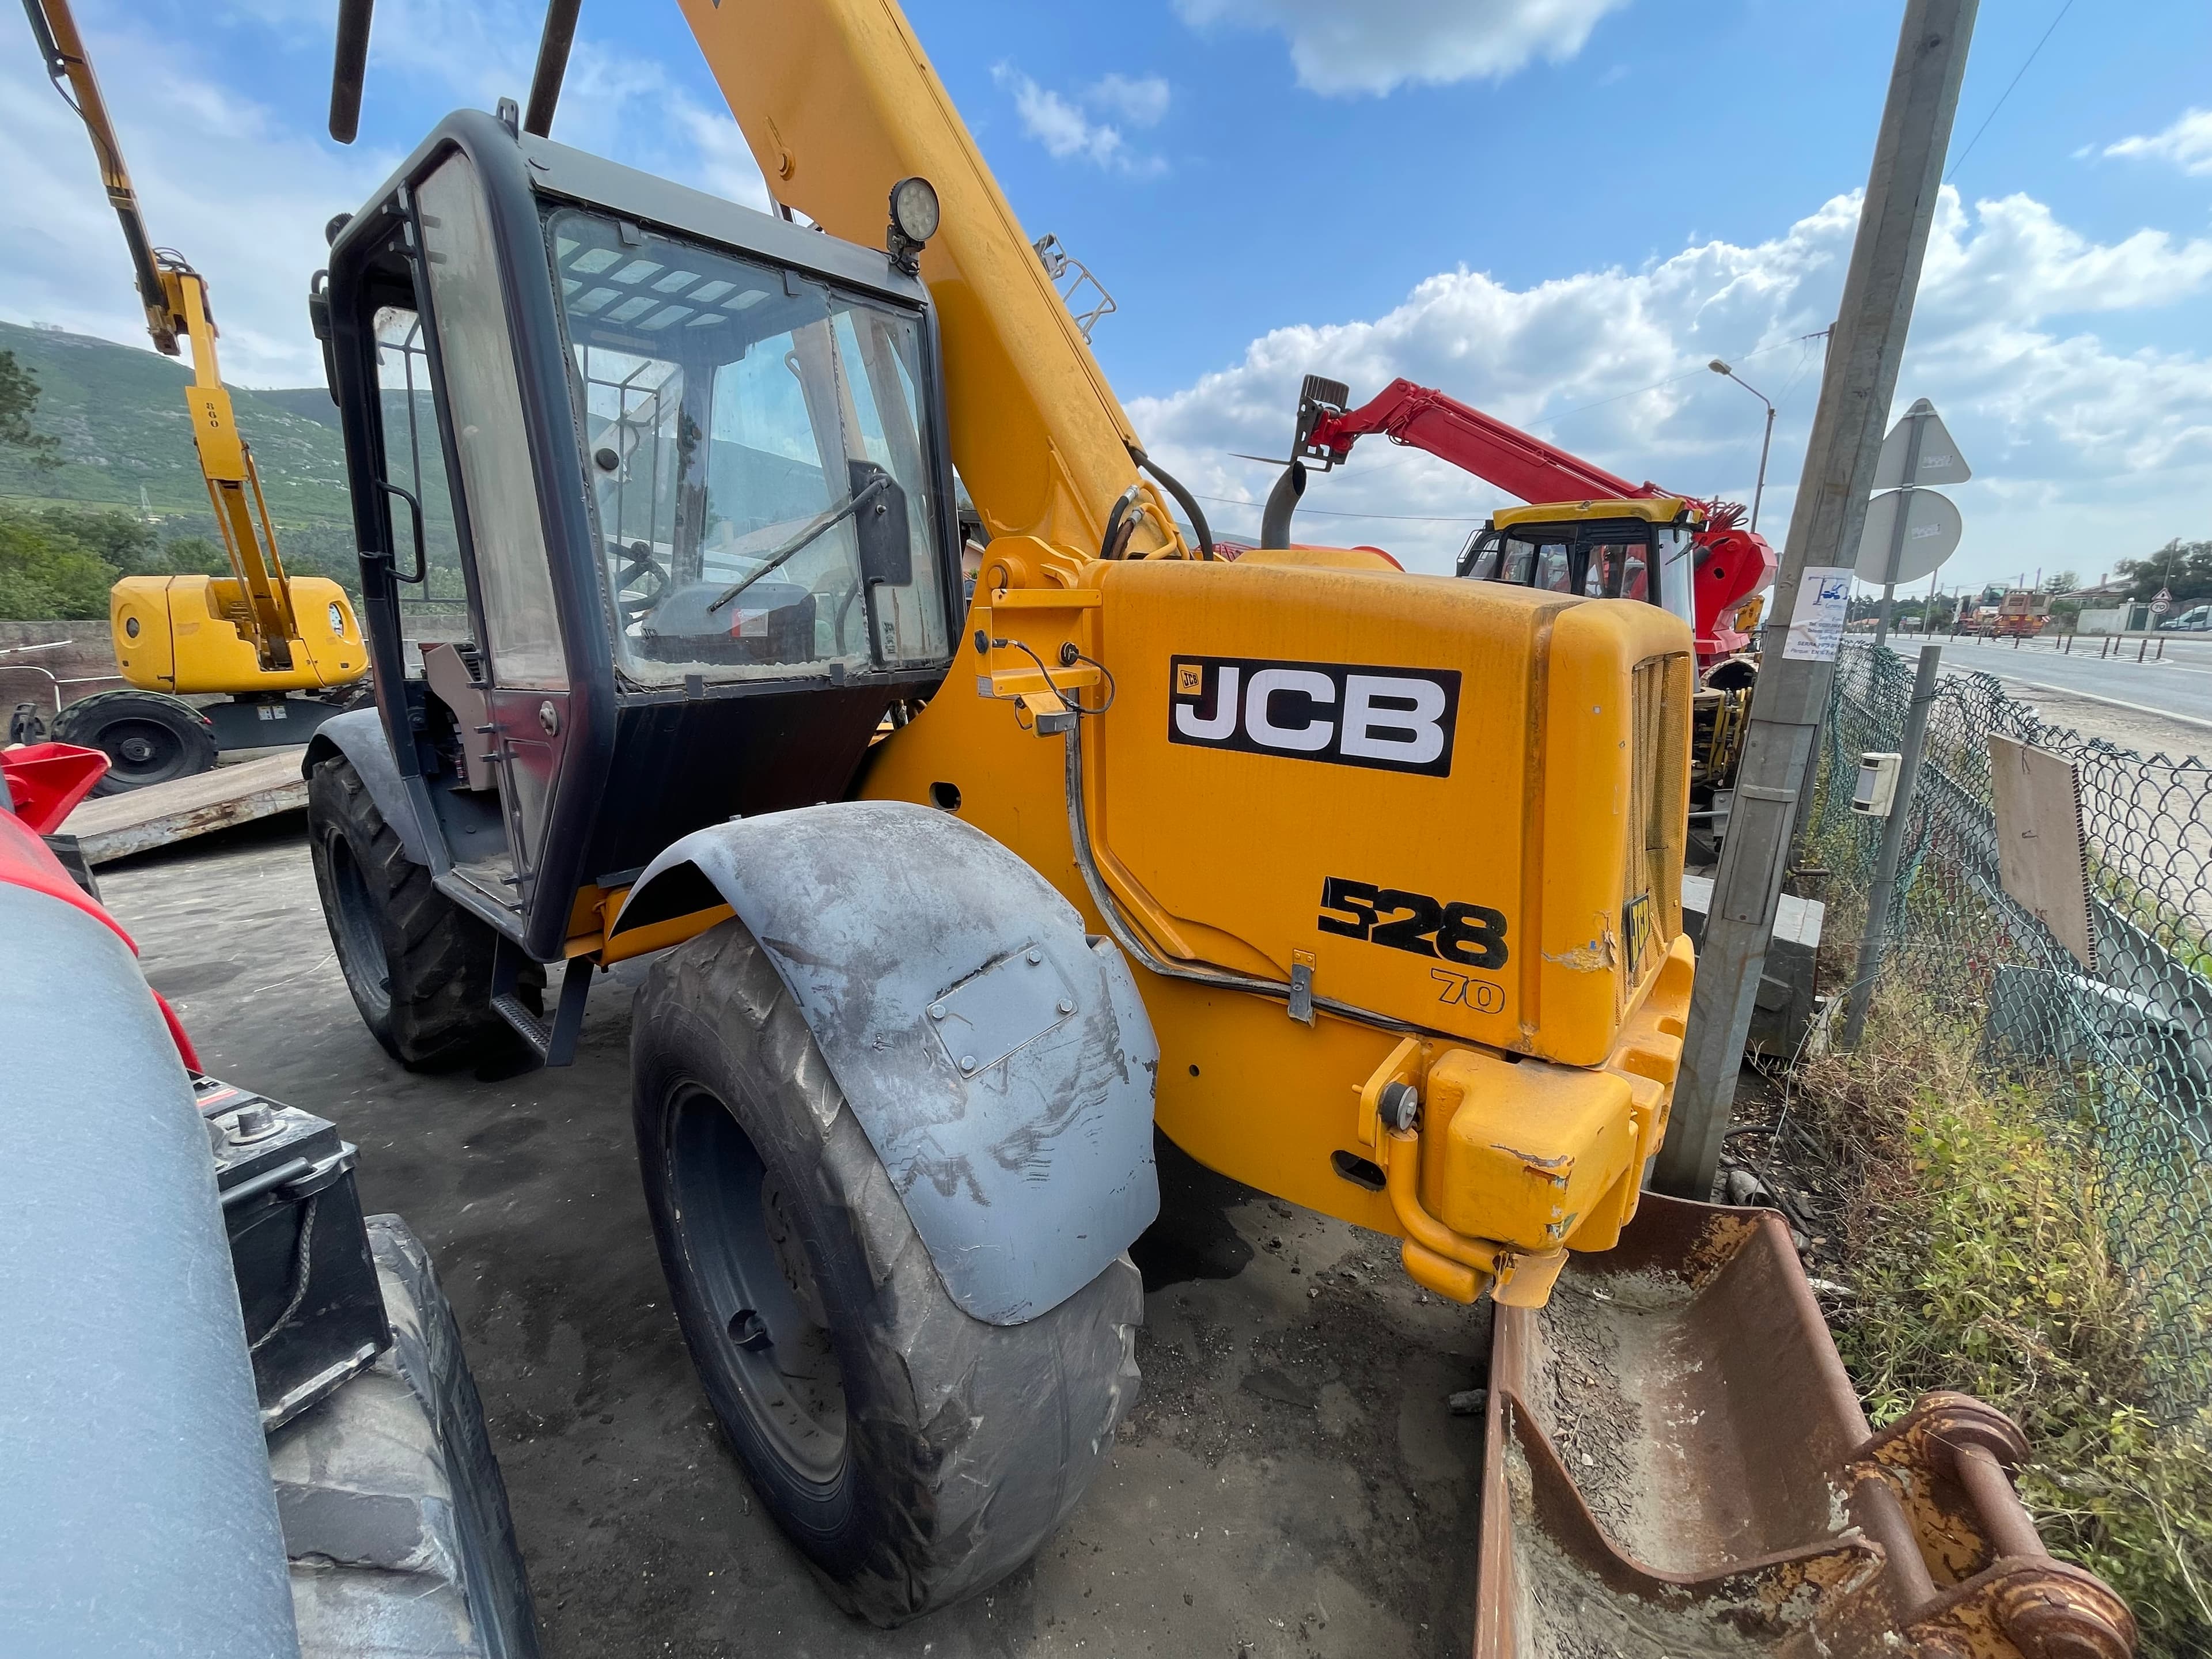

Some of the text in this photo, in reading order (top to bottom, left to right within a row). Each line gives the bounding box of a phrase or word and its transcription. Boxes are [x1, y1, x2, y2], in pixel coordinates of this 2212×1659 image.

[206, 402, 219, 427] 860
[1184, 671, 1198, 686] JCB
[1176, 666, 1446, 763] JCB
[1317, 876, 1509, 970] 528
[1631, 899, 1649, 967] JCB
[1431, 968, 1505, 1014] 70
